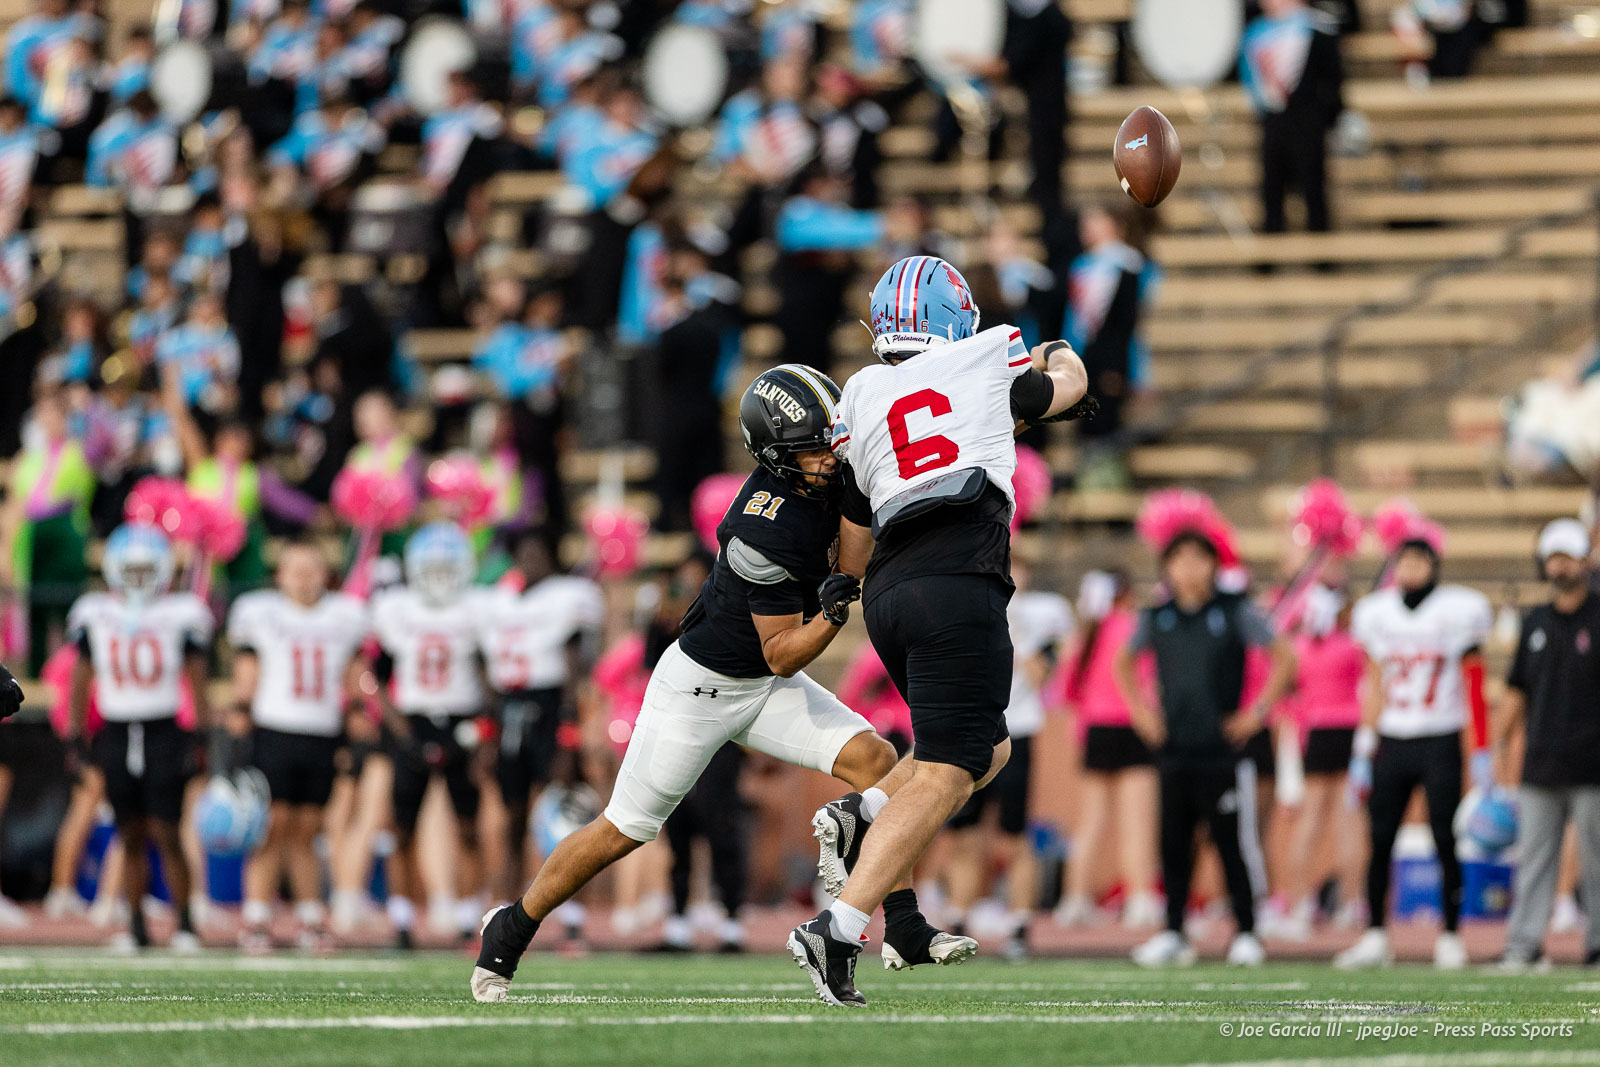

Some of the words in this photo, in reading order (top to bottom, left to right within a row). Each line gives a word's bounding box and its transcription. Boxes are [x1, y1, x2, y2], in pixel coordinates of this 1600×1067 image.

[892, 334, 926, 343] Plainsmen
[920, 320, 929, 333] 6
[753, 379, 807, 423] SANDIES
[886, 388, 960, 481] 6
[742, 490, 786, 521] 21
[109, 629, 165, 691] 10
[291, 642, 326, 701] 11
[1384, 651, 1447, 711] 27
